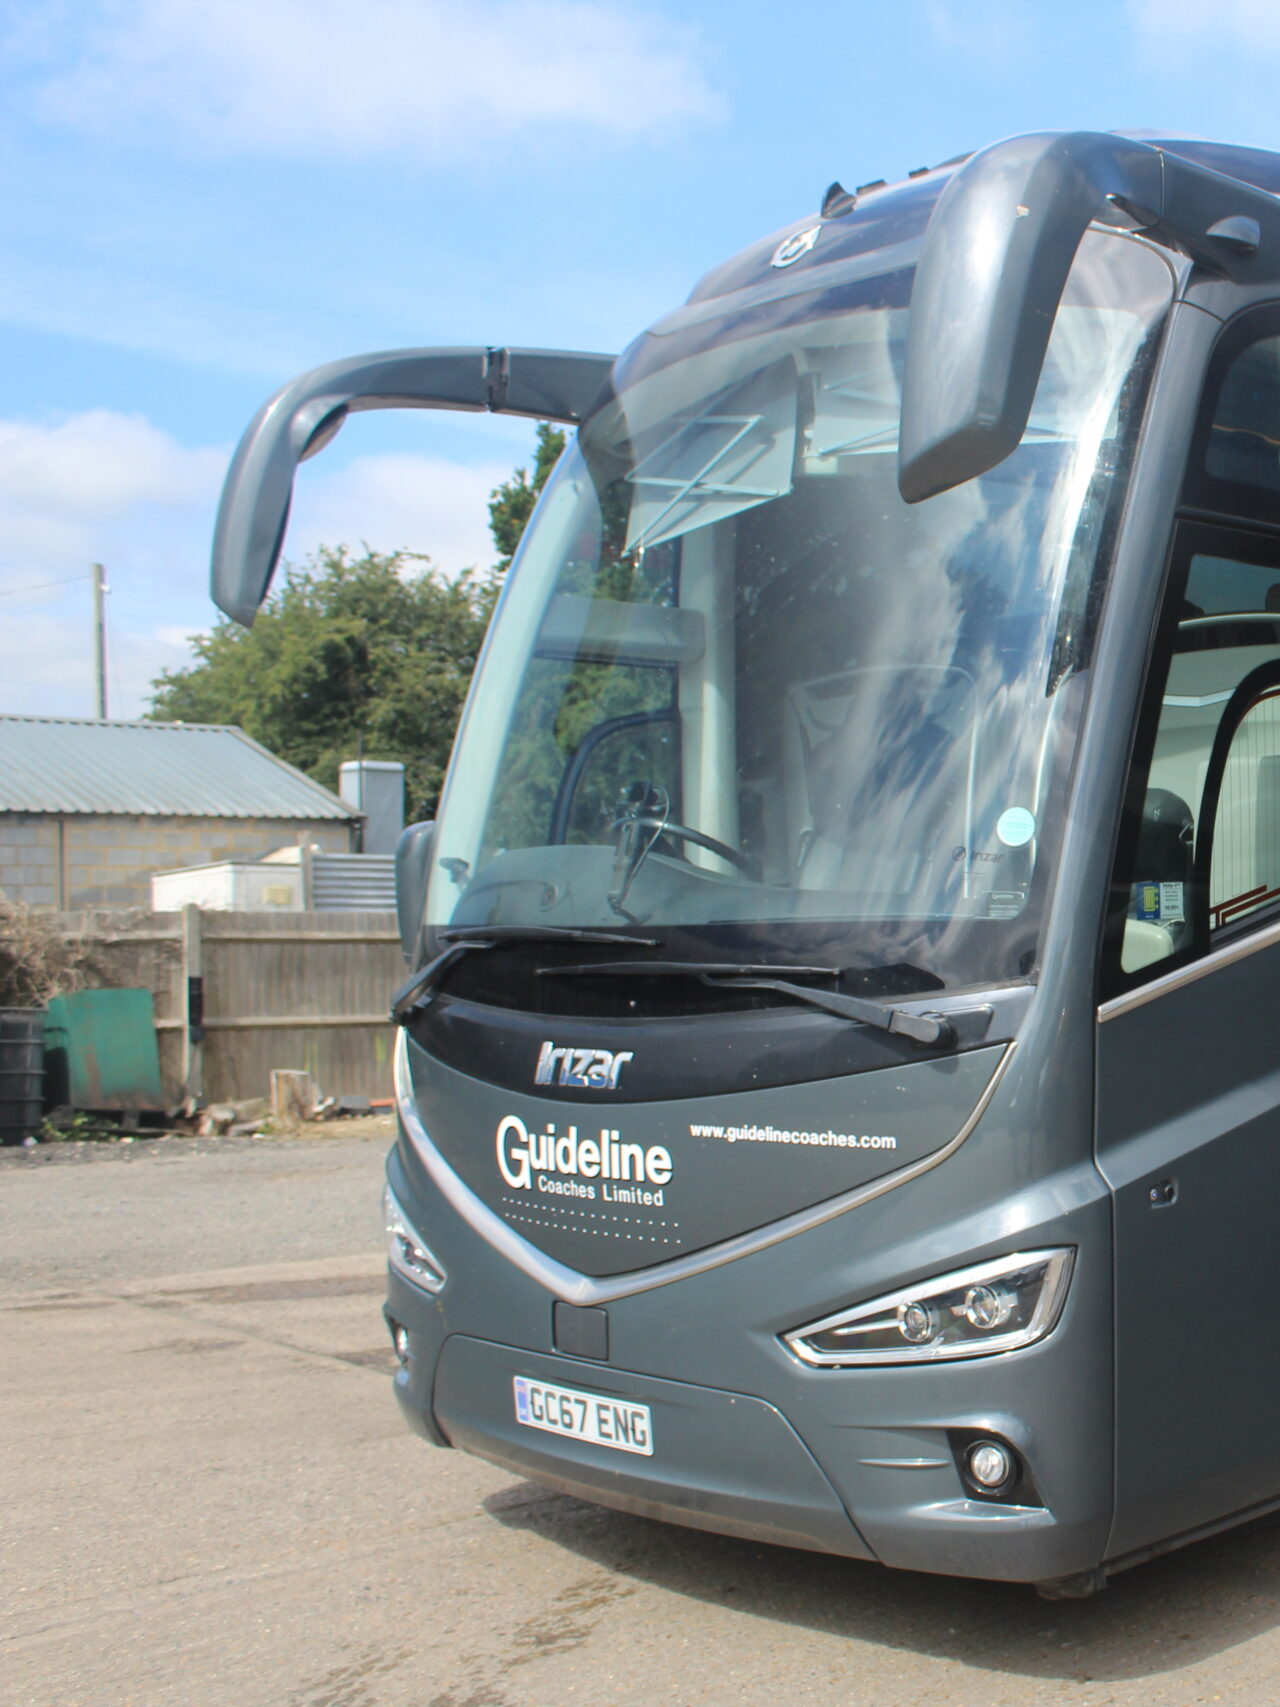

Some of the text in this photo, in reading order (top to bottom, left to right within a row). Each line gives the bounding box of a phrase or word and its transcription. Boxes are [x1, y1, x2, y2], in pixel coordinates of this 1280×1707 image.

[496, 1115, 672, 1190] Guideline
[689, 1124, 897, 1149] www.guidelinecoaches.com
[538, 1174, 664, 1207] Coaches Limited
[530, 1386, 648, 1447] GC67 ENG
